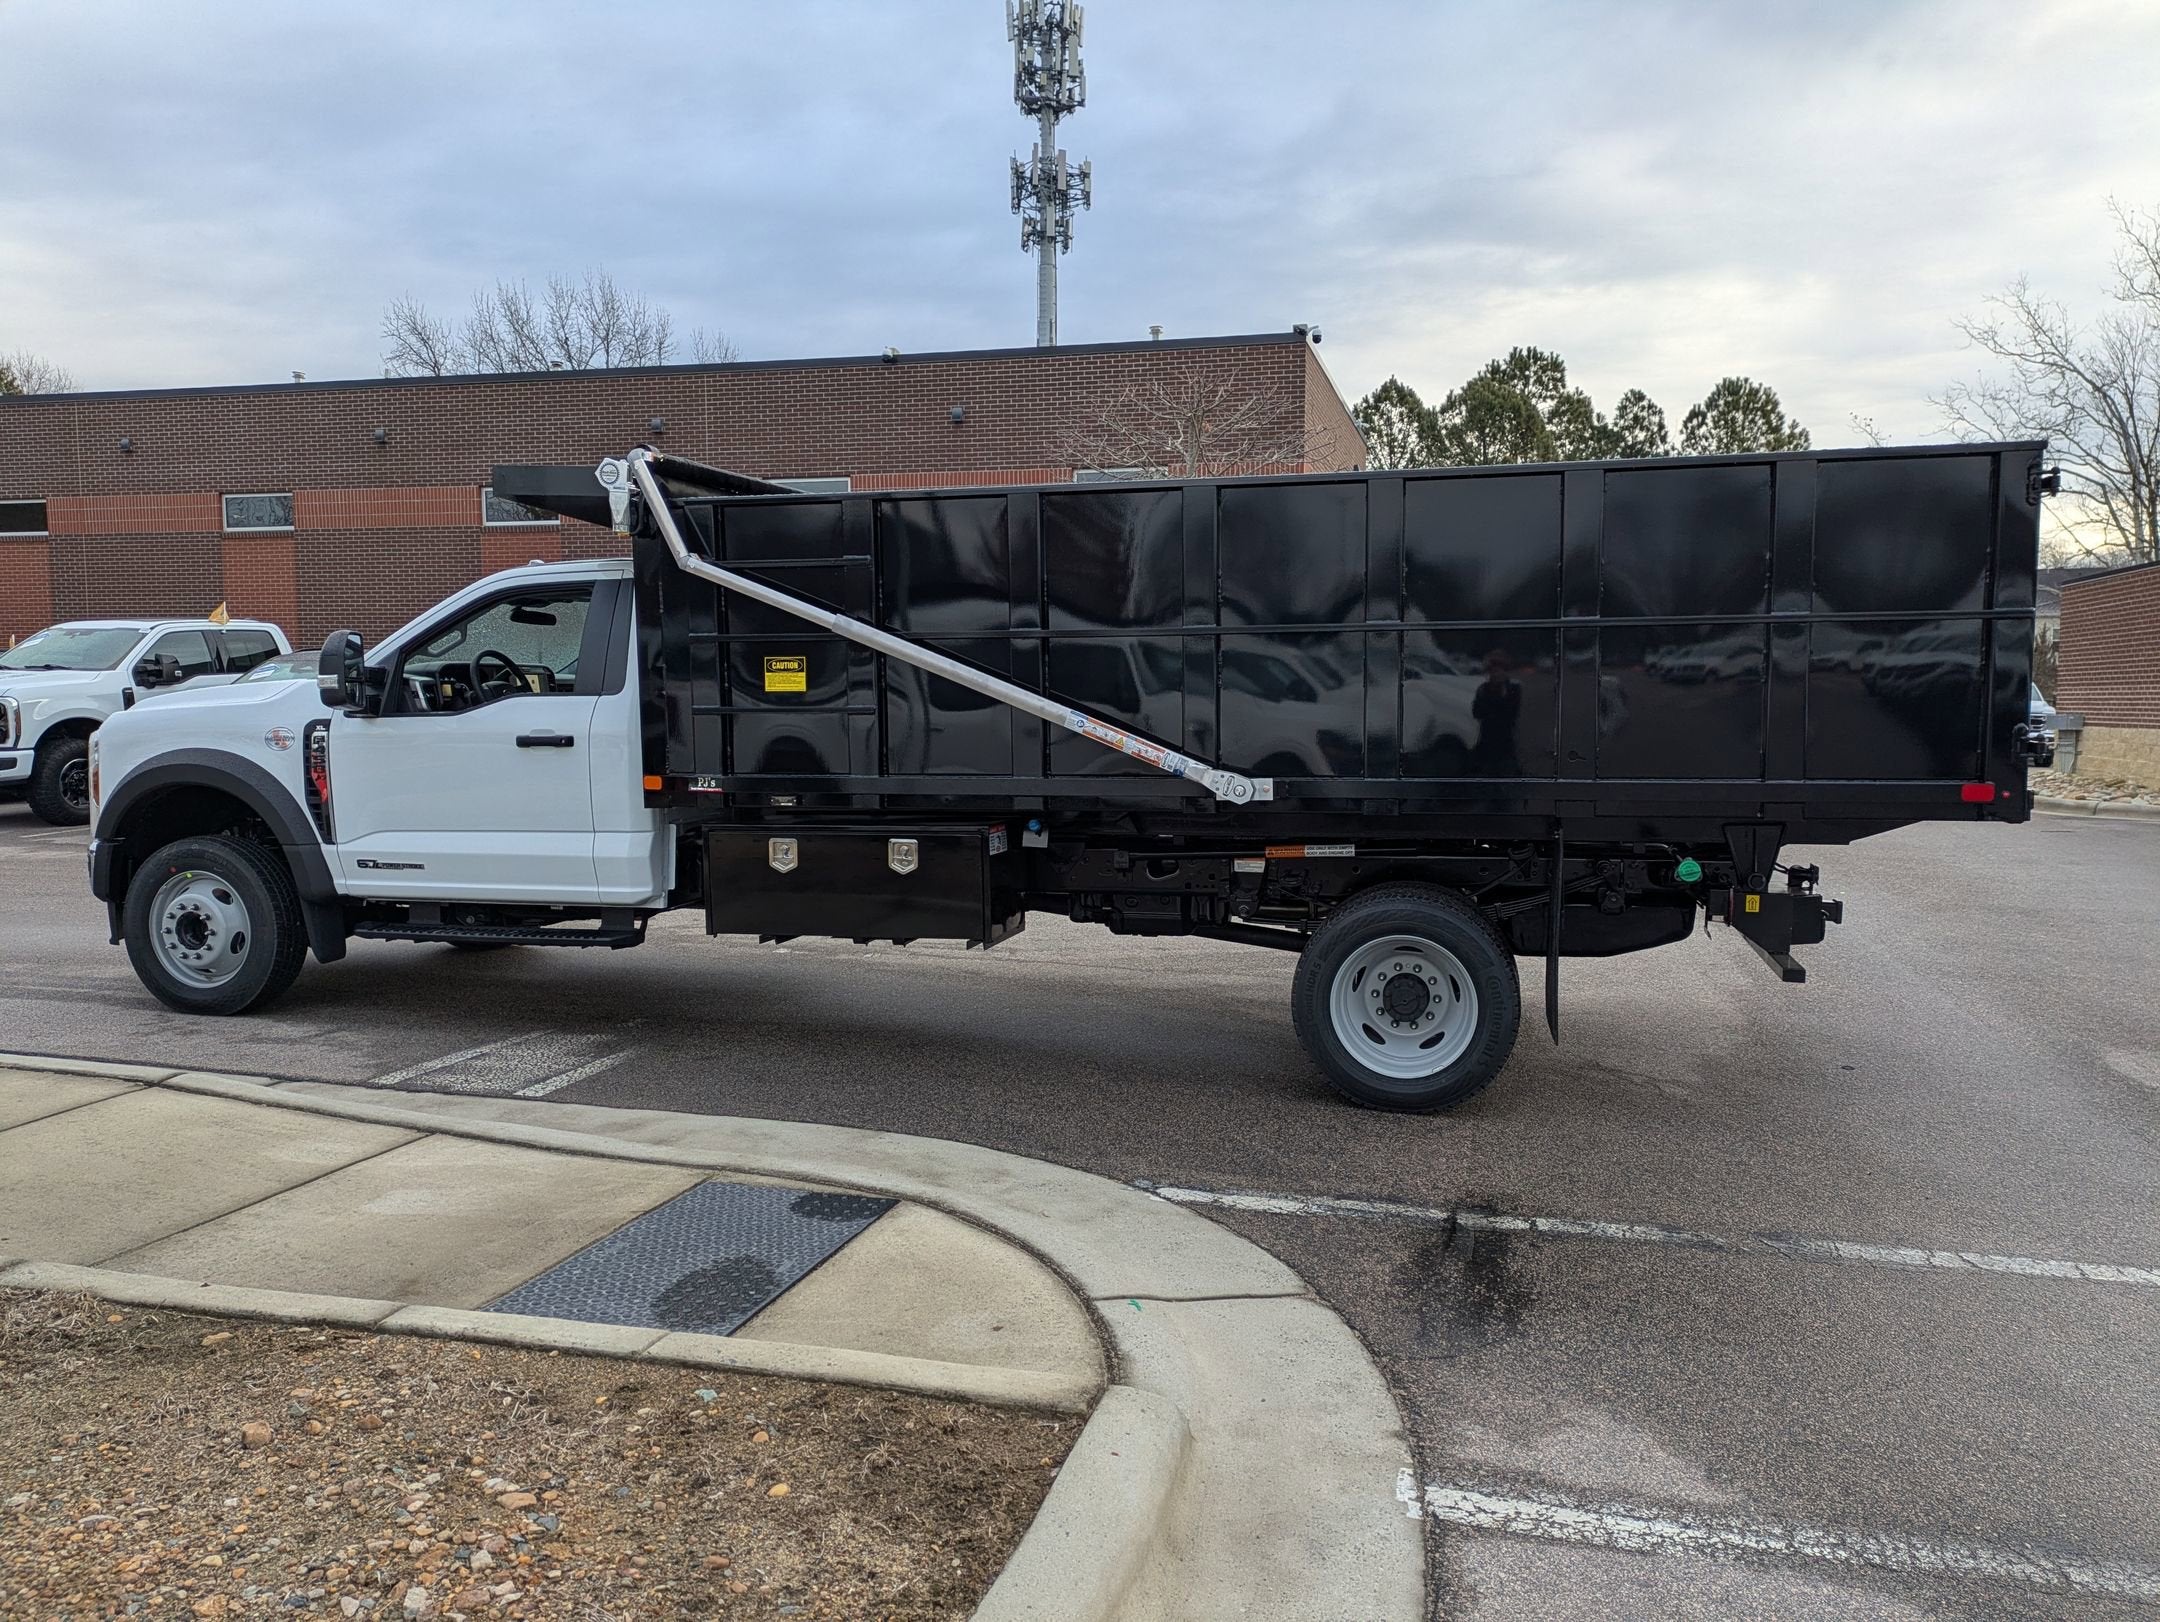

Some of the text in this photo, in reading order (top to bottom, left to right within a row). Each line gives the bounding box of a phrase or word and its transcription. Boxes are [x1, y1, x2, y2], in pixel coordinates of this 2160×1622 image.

[771, 661, 799, 670] CAUTION
[697, 776, 716, 788] PJ's
[356, 859, 382, 869] 6.7L
[1482, 976, 1505, 1058] Continental
